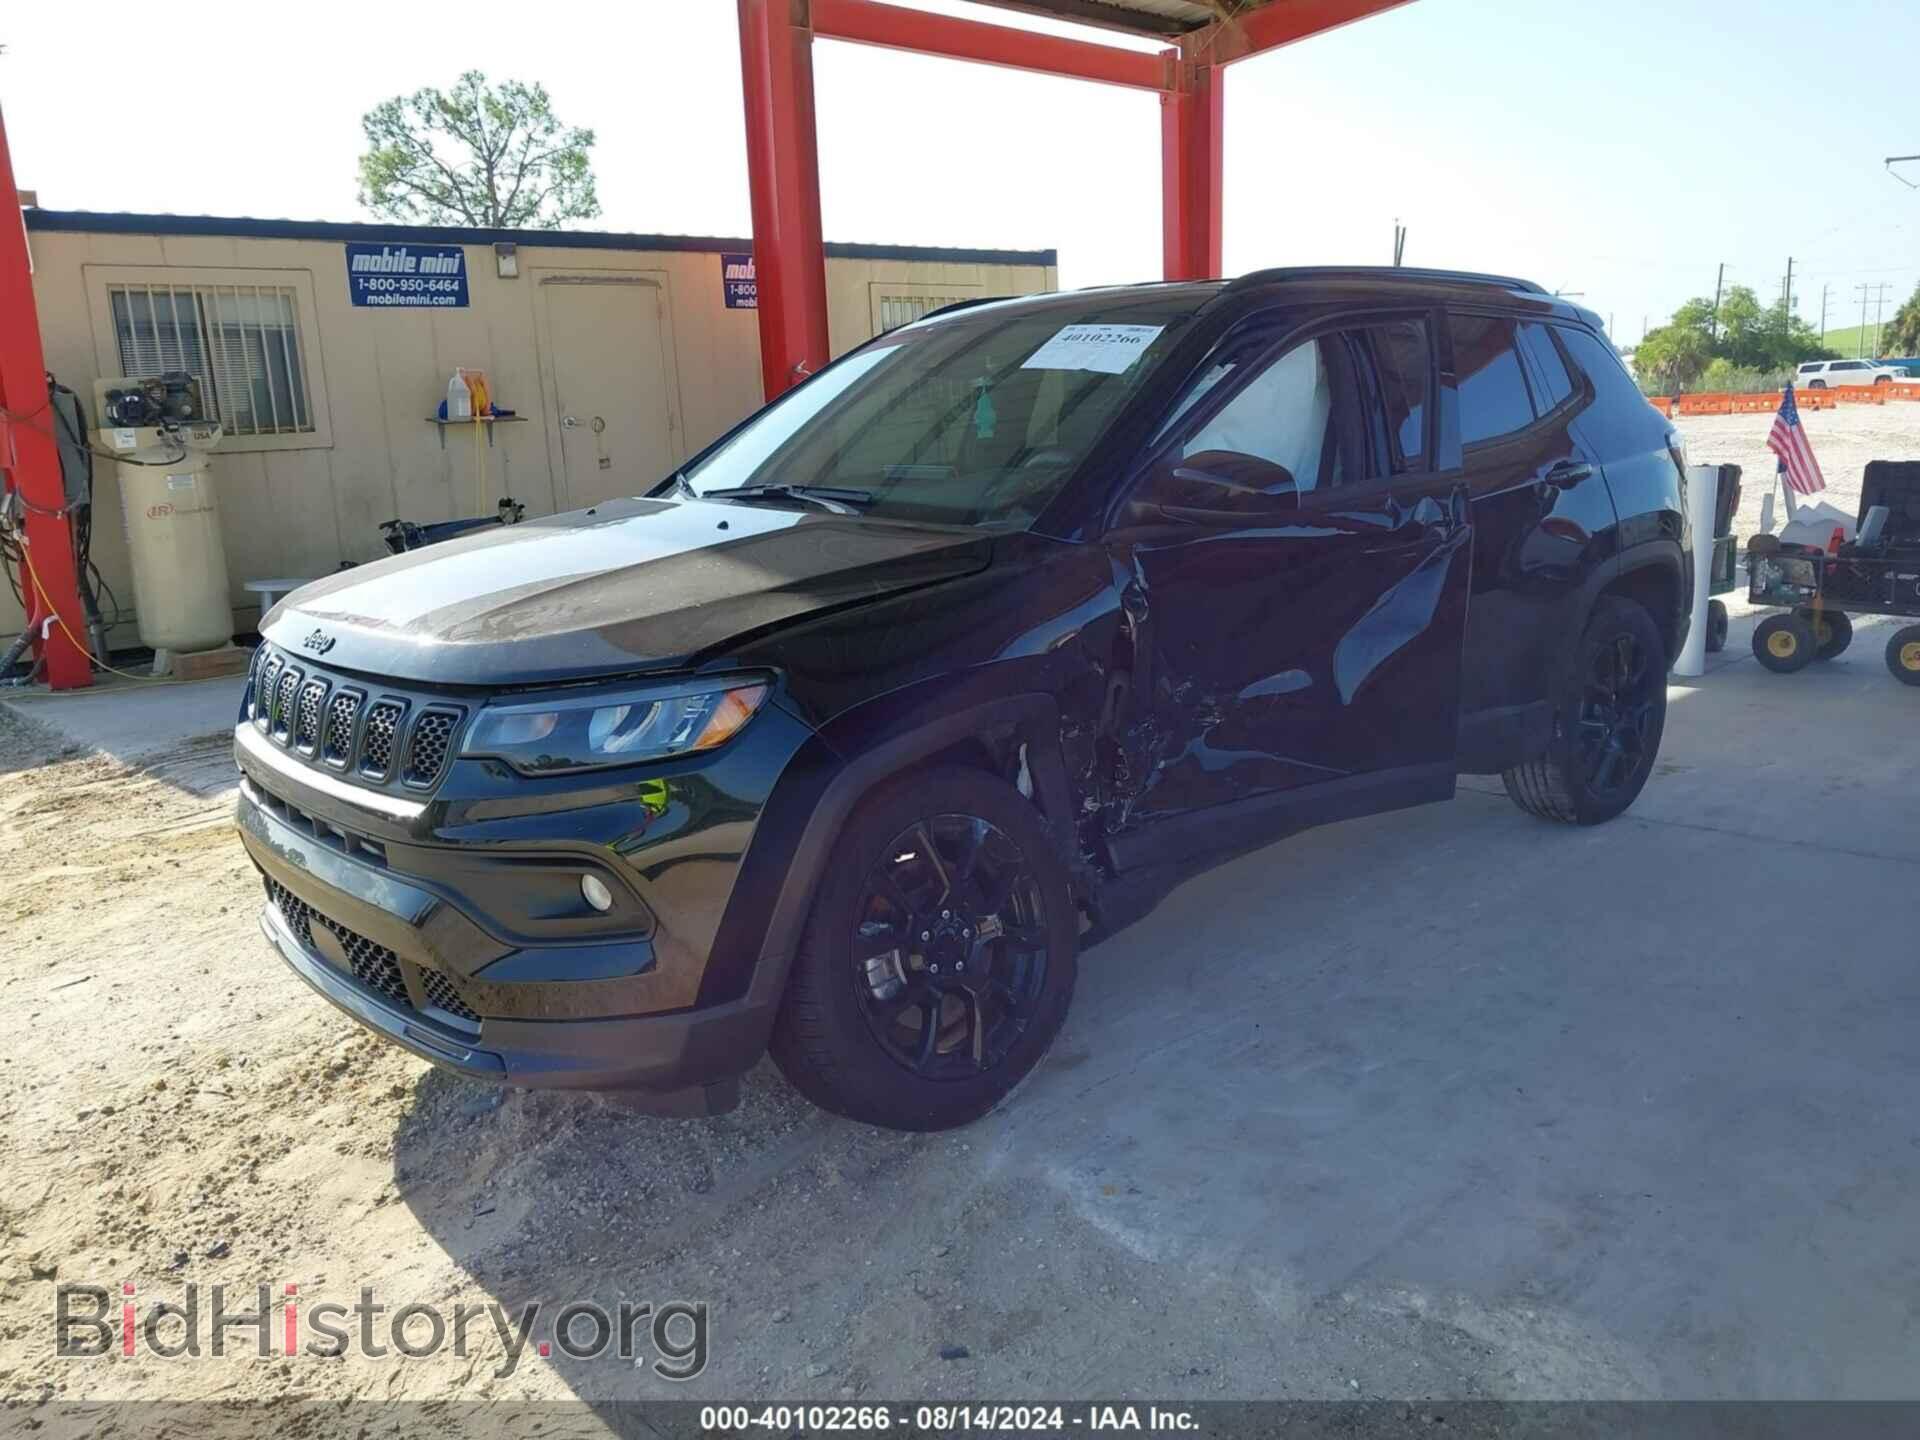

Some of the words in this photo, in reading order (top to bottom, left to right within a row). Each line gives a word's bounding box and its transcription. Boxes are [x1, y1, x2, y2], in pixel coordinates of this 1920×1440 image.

[351, 246, 417, 273] mobile
[419, 252, 463, 274] mini
[358, 278, 459, 292] 1-800-950-6464
[366, 293, 456, 306] mobilemini.com
[1062, 333, 1141, 344] 40102266
[193, 431, 211, 440] USA
[304, 628, 336, 655] Jeep
